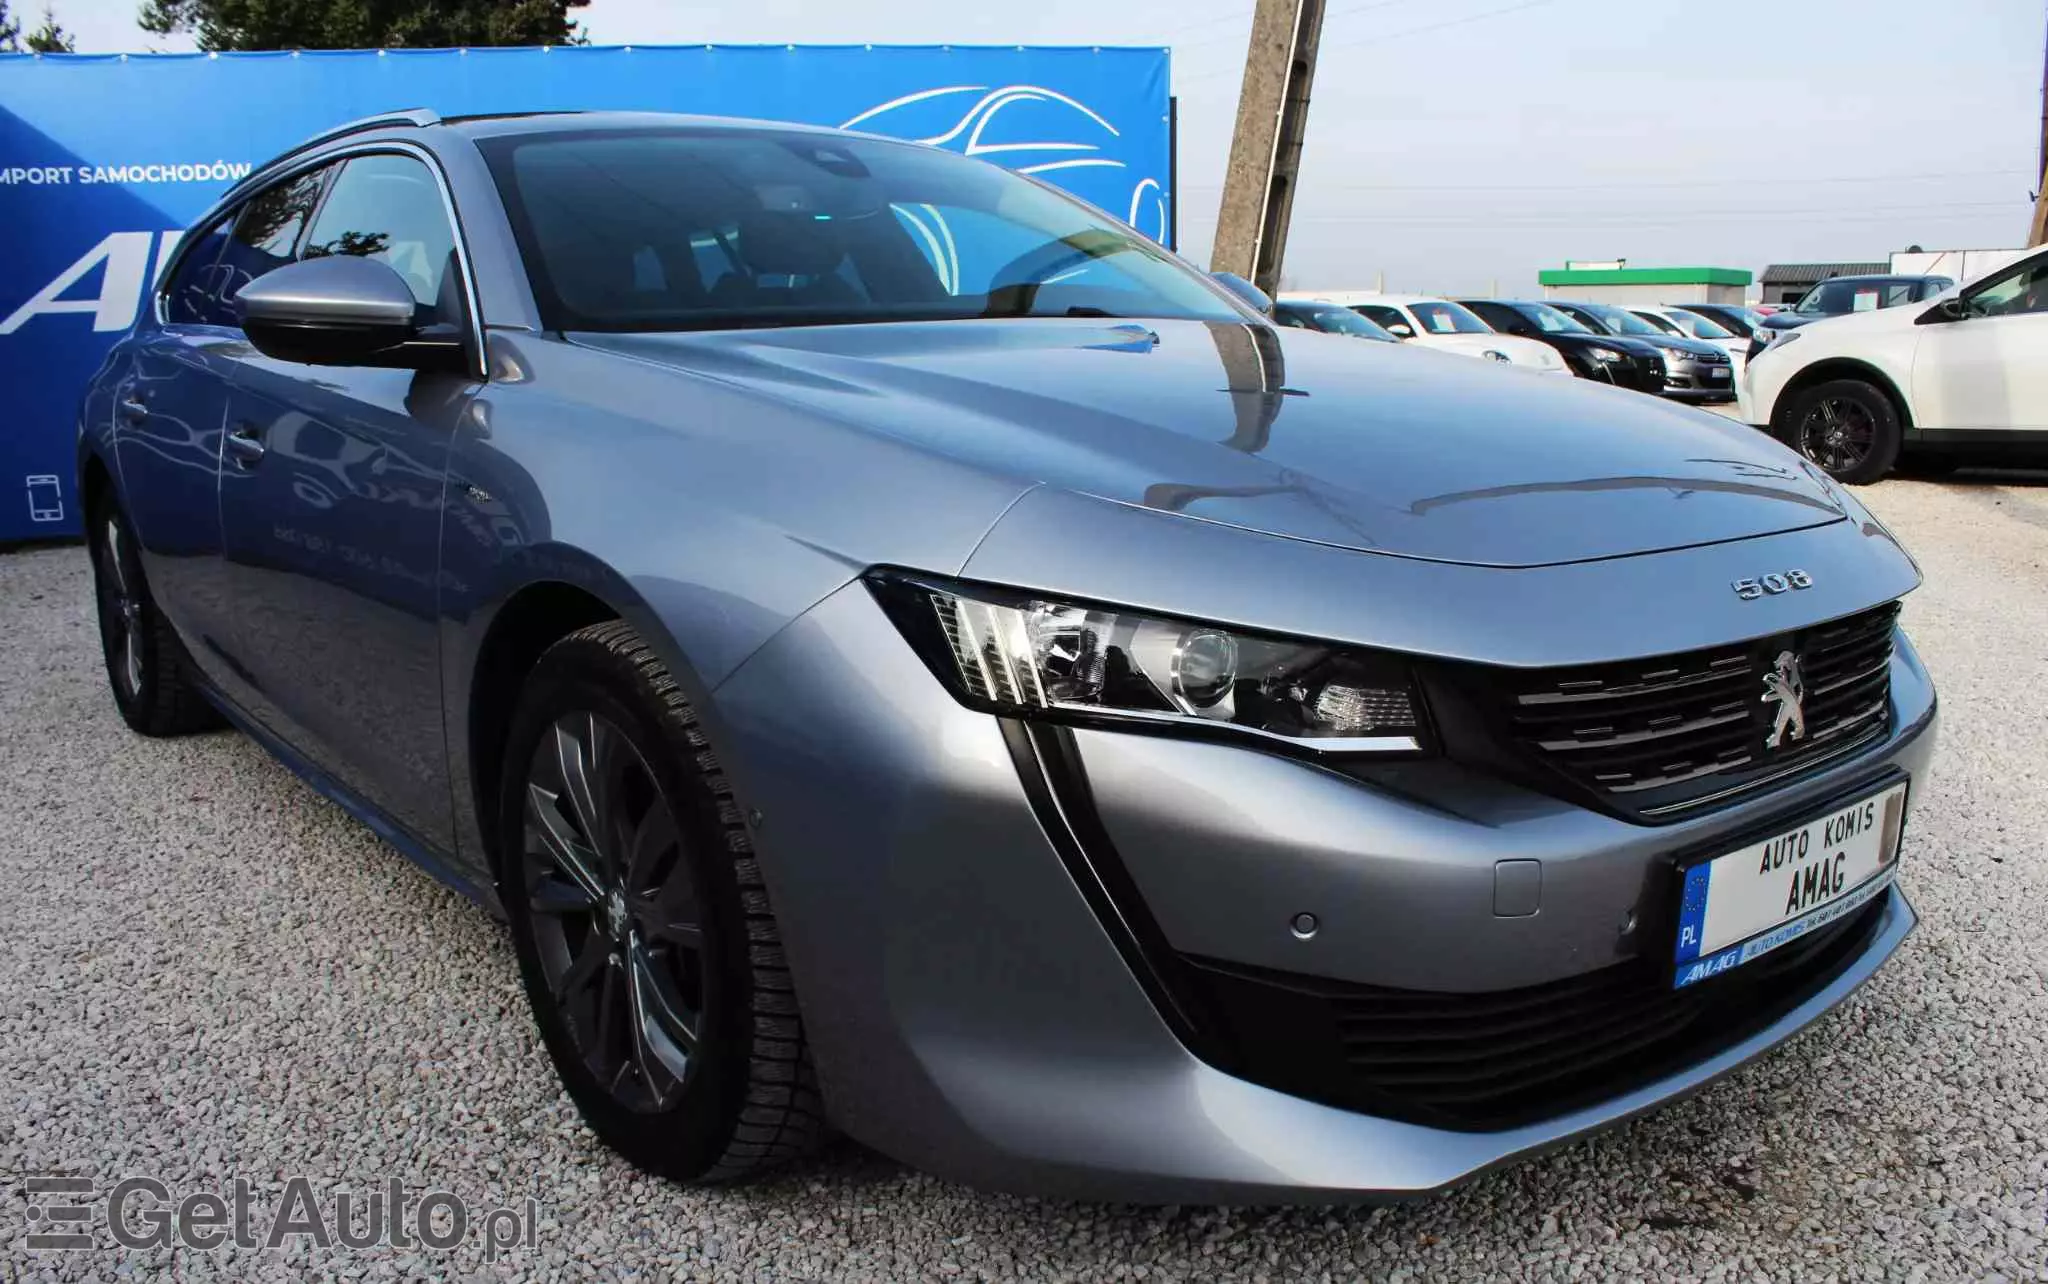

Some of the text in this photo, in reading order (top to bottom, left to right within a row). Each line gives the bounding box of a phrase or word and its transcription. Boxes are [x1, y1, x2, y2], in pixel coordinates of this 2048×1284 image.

[78, 160, 251, 184] SAMOCHODÓW
[1730, 569, 1813, 600] 508
[1760, 802, 1874, 874] AUTO KOMIS
[1785, 851, 1846, 915] AMAG
[1680, 924, 1697, 948] PL
[1680, 950, 1738, 985] AMAG
